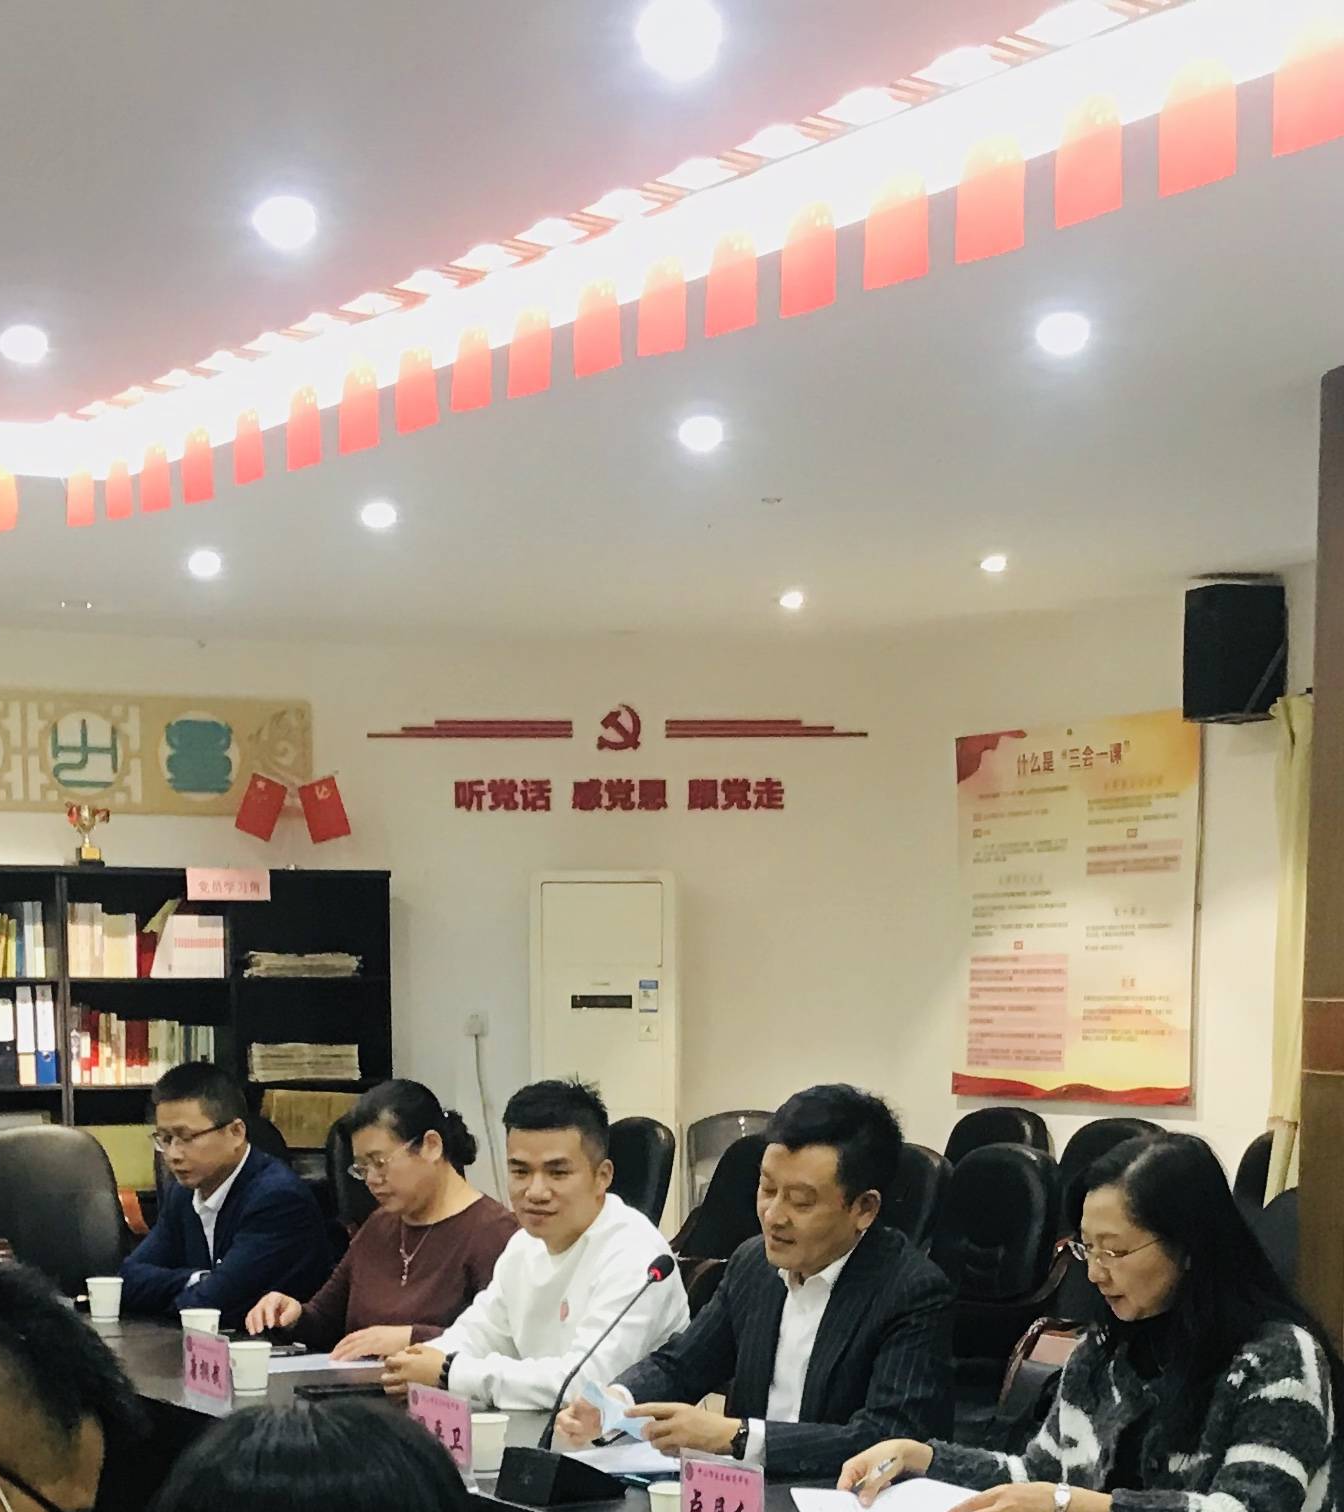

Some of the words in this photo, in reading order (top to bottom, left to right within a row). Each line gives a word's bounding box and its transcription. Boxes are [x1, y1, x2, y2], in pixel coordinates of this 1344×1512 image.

[454, 779, 551, 812] 听党话
[572, 779, 667, 811] 感党恩
[687, 778, 784, 811] 跟党走
